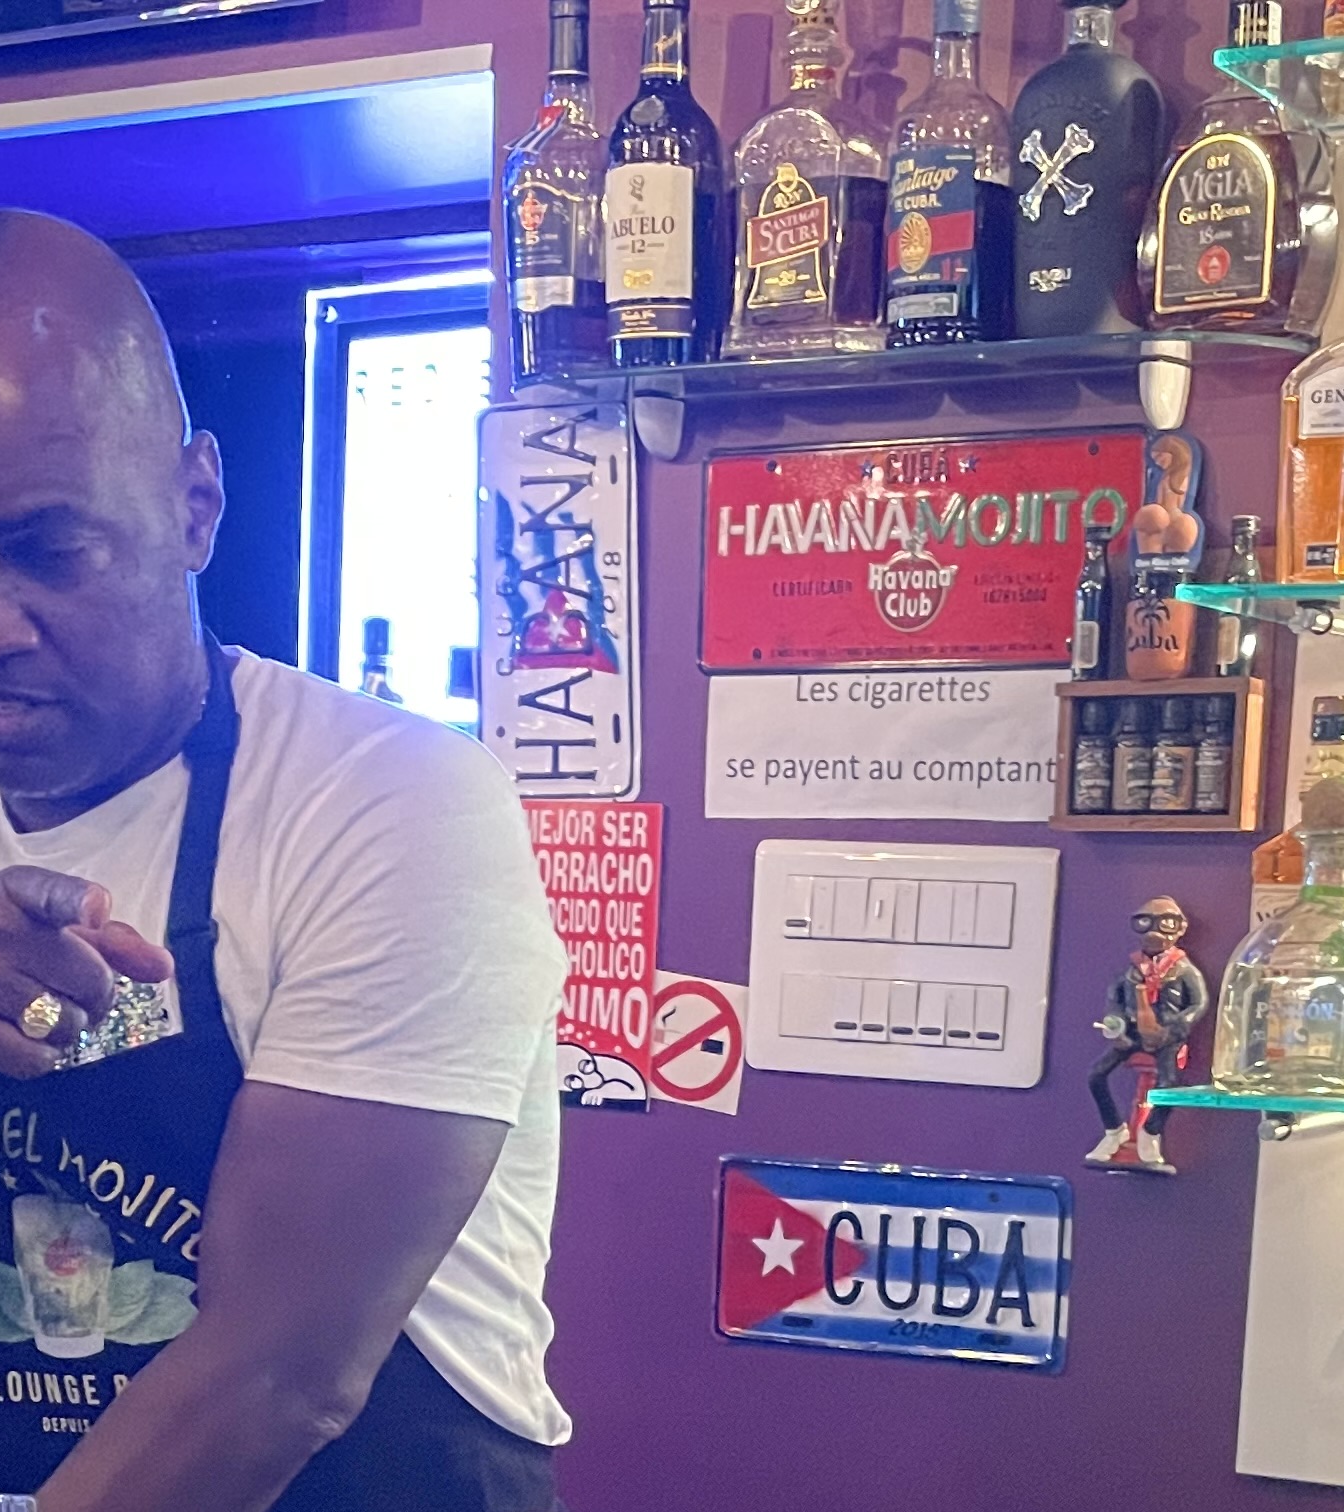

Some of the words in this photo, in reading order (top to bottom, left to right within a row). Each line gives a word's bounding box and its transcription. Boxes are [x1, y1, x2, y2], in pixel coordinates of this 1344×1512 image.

[1178, 167, 1254, 203] VIGIA
[611, 215, 675, 241] ABUELO
[867, 561, 959, 591] Havana
[514, 408, 598, 783] HABANA
[884, 591, 932, 618] Club
[796, 676, 839, 702] Les
[847, 675, 992, 710] cigarettes
[726, 758, 755, 779] se
[765, 755, 861, 787] payent
[869, 759, 903, 781] au
[912, 757, 1058, 789] comptant
[602, 810, 648, 848] SER
[536, 849, 653, 896] ORRACHO
[547, 897, 600, 935] OCIDO
[606, 899, 644, 942] QUE
[566, 939, 645, 982] HOLICO
[561, 983, 649, 1049] NIMO
[823, 1209, 1036, 1328] CUBA
